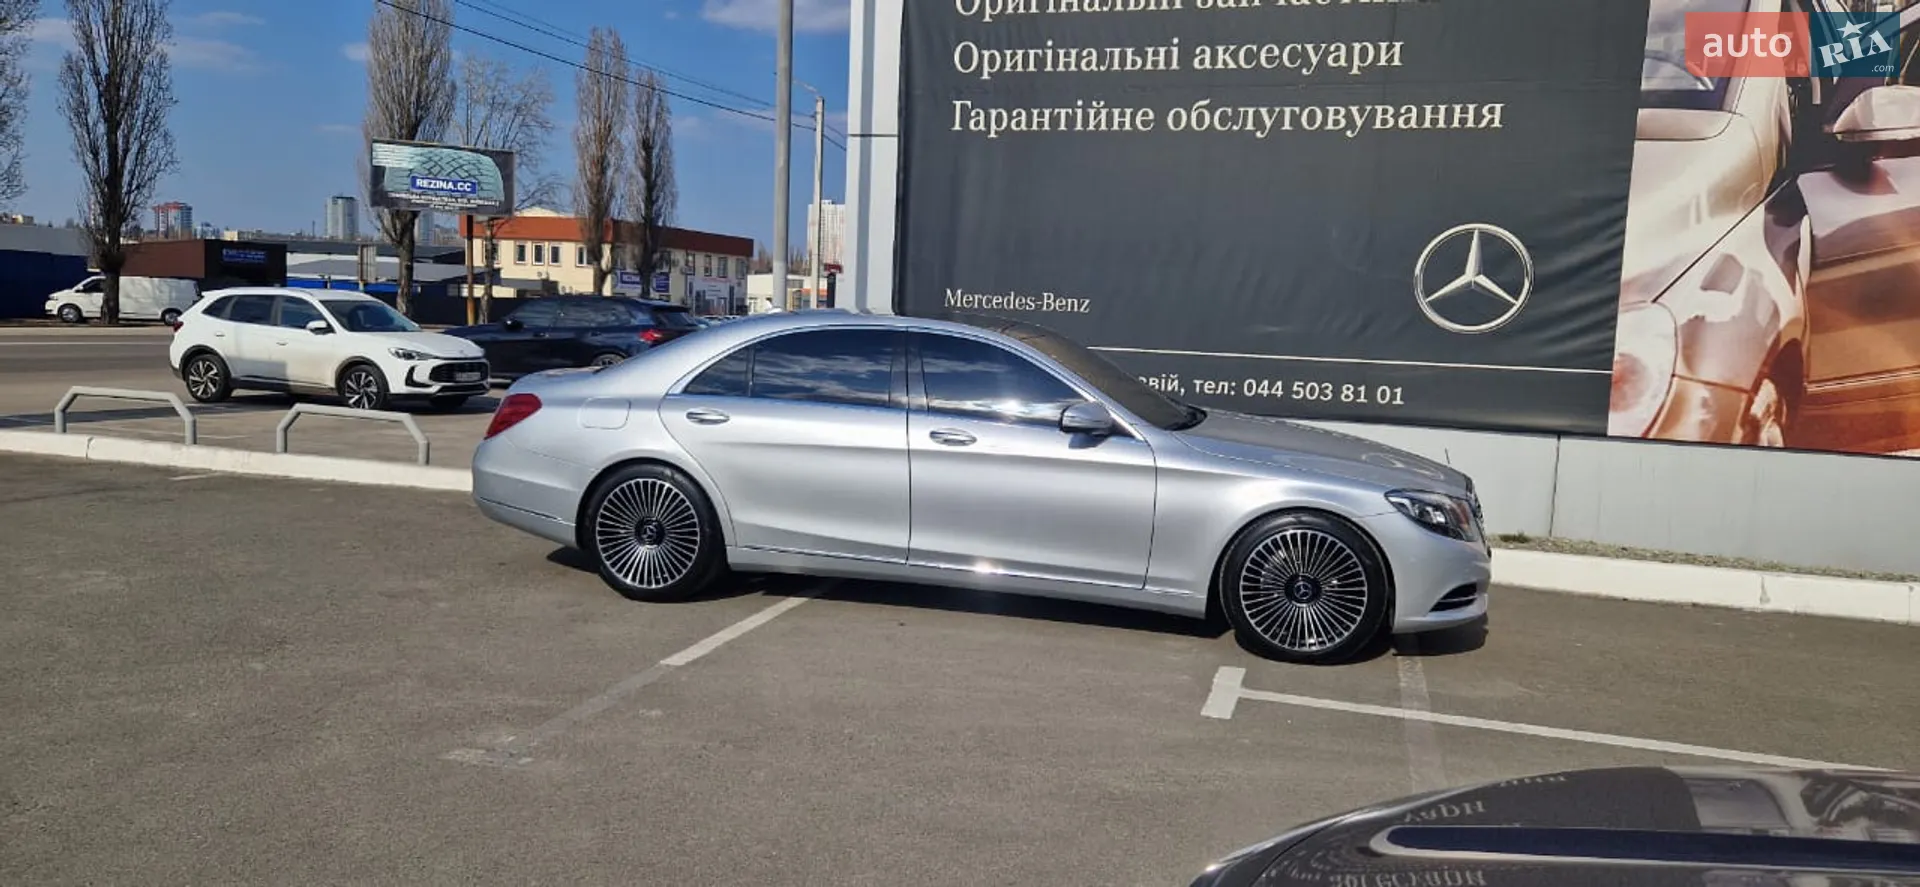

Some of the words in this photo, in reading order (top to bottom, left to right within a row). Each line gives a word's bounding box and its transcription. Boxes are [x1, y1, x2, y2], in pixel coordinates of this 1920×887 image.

[953, 37, 1181, 80] Оригінальні
[1192, 41, 1405, 76] аксесуари
[950, 99, 1155, 139] Гарантійне
[1166, 97, 1506, 139] обслуговування
[416, 178, 472, 192] REZINA.CC
[944, 287, 1091, 314] Mercedes-Benz
[1192, 379, 1236, 396] тел:
[1243, 378, 1284, 398] 044
[1291, 380, 1334, 402] 503
[1340, 383, 1368, 404] 81
[1376, 385, 1405, 405] 01
